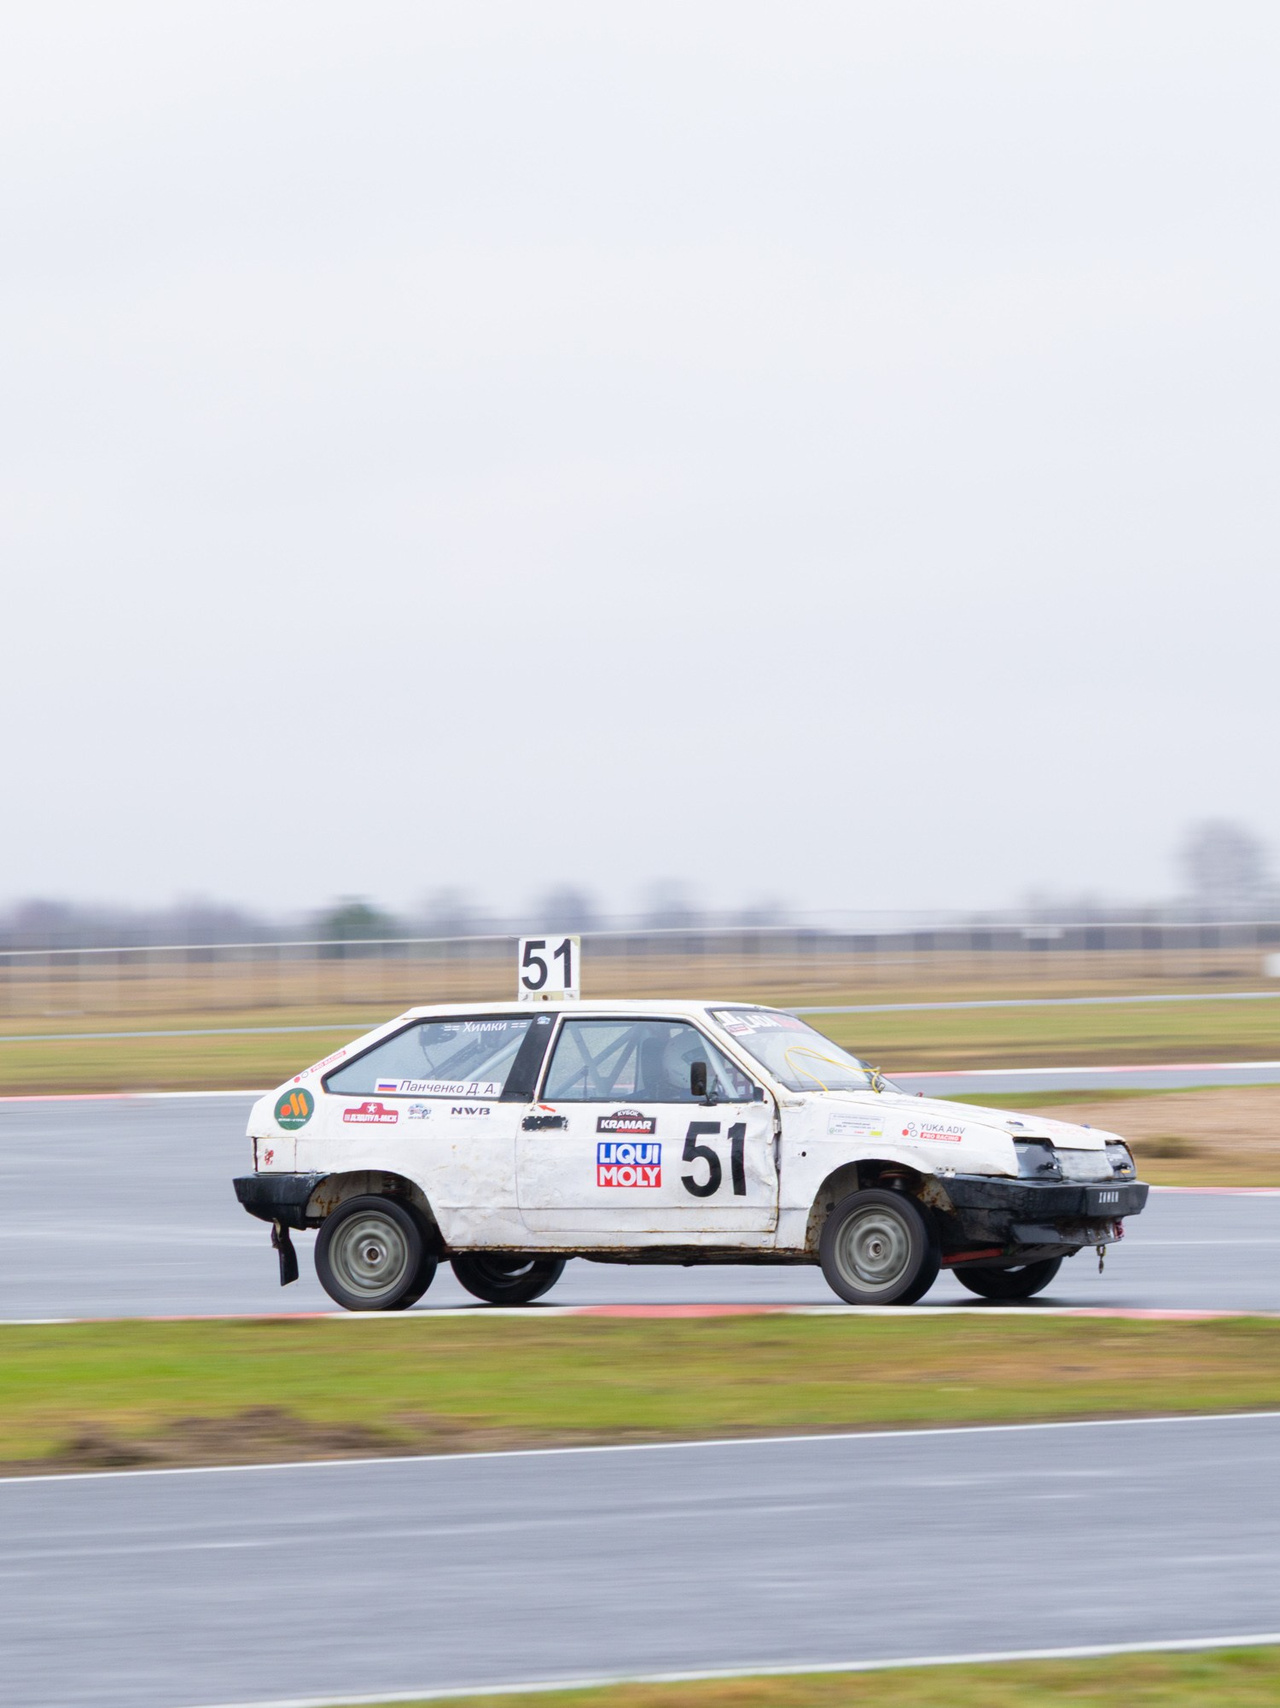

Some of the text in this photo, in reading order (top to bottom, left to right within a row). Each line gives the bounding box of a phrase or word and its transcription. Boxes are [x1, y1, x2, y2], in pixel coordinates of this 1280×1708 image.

[521, 938, 571, 990] 51
[462, 1021, 507, 1033] Химки
[400, 1080, 497, 1096] Панченко Д. А.
[451, 1107, 490, 1115] NWB
[600, 1119, 652, 1130] KRAMAR
[920, 1123, 966, 1134] YUKA ADV
[599, 1143, 660, 1165] LIQUI
[681, 1121, 747, 1198] 51
[599, 1166, 661, 1187] MOLY
